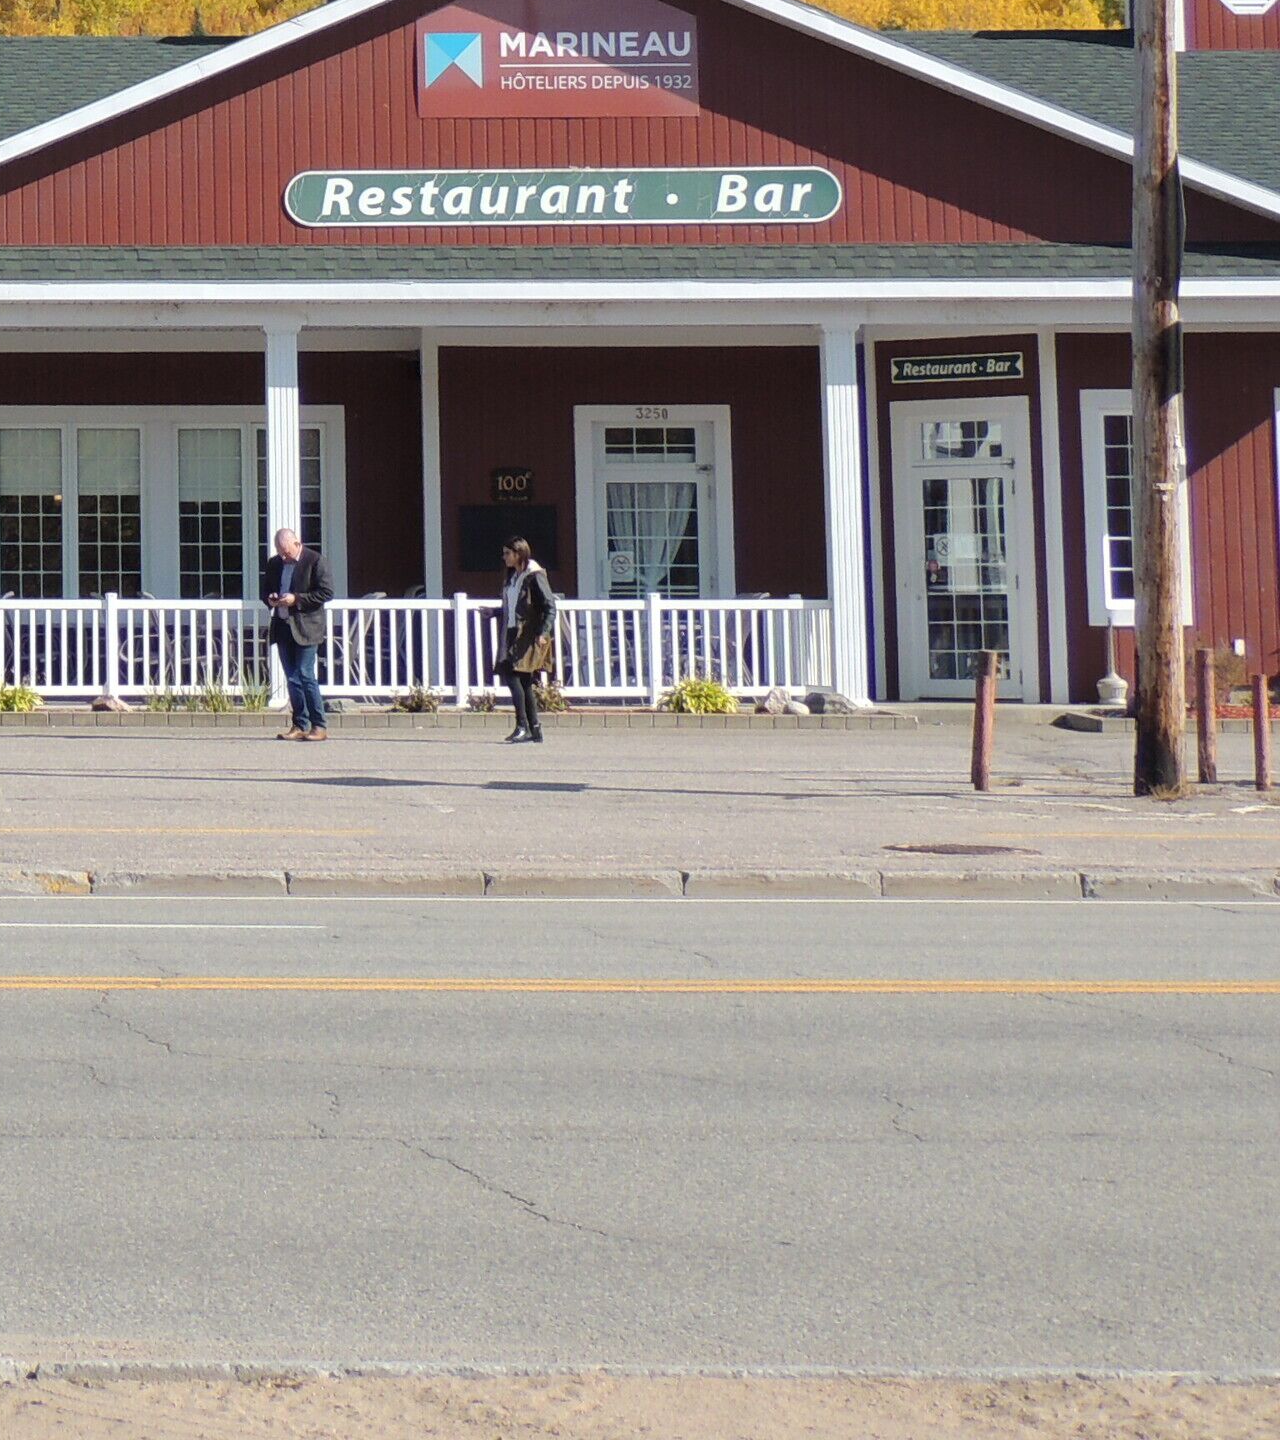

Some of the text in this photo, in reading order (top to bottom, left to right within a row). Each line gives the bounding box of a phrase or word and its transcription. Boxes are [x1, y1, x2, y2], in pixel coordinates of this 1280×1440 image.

[500, 31, 692, 58] MARINEAU
[501, 72, 693, 90] HÔTELIERS DEPUIS 1932
[321, 173, 814, 216] Restaurant Bar
[902, 358, 1011, 376] Restaurant Bar
[635, 407, 669, 420] 3250
